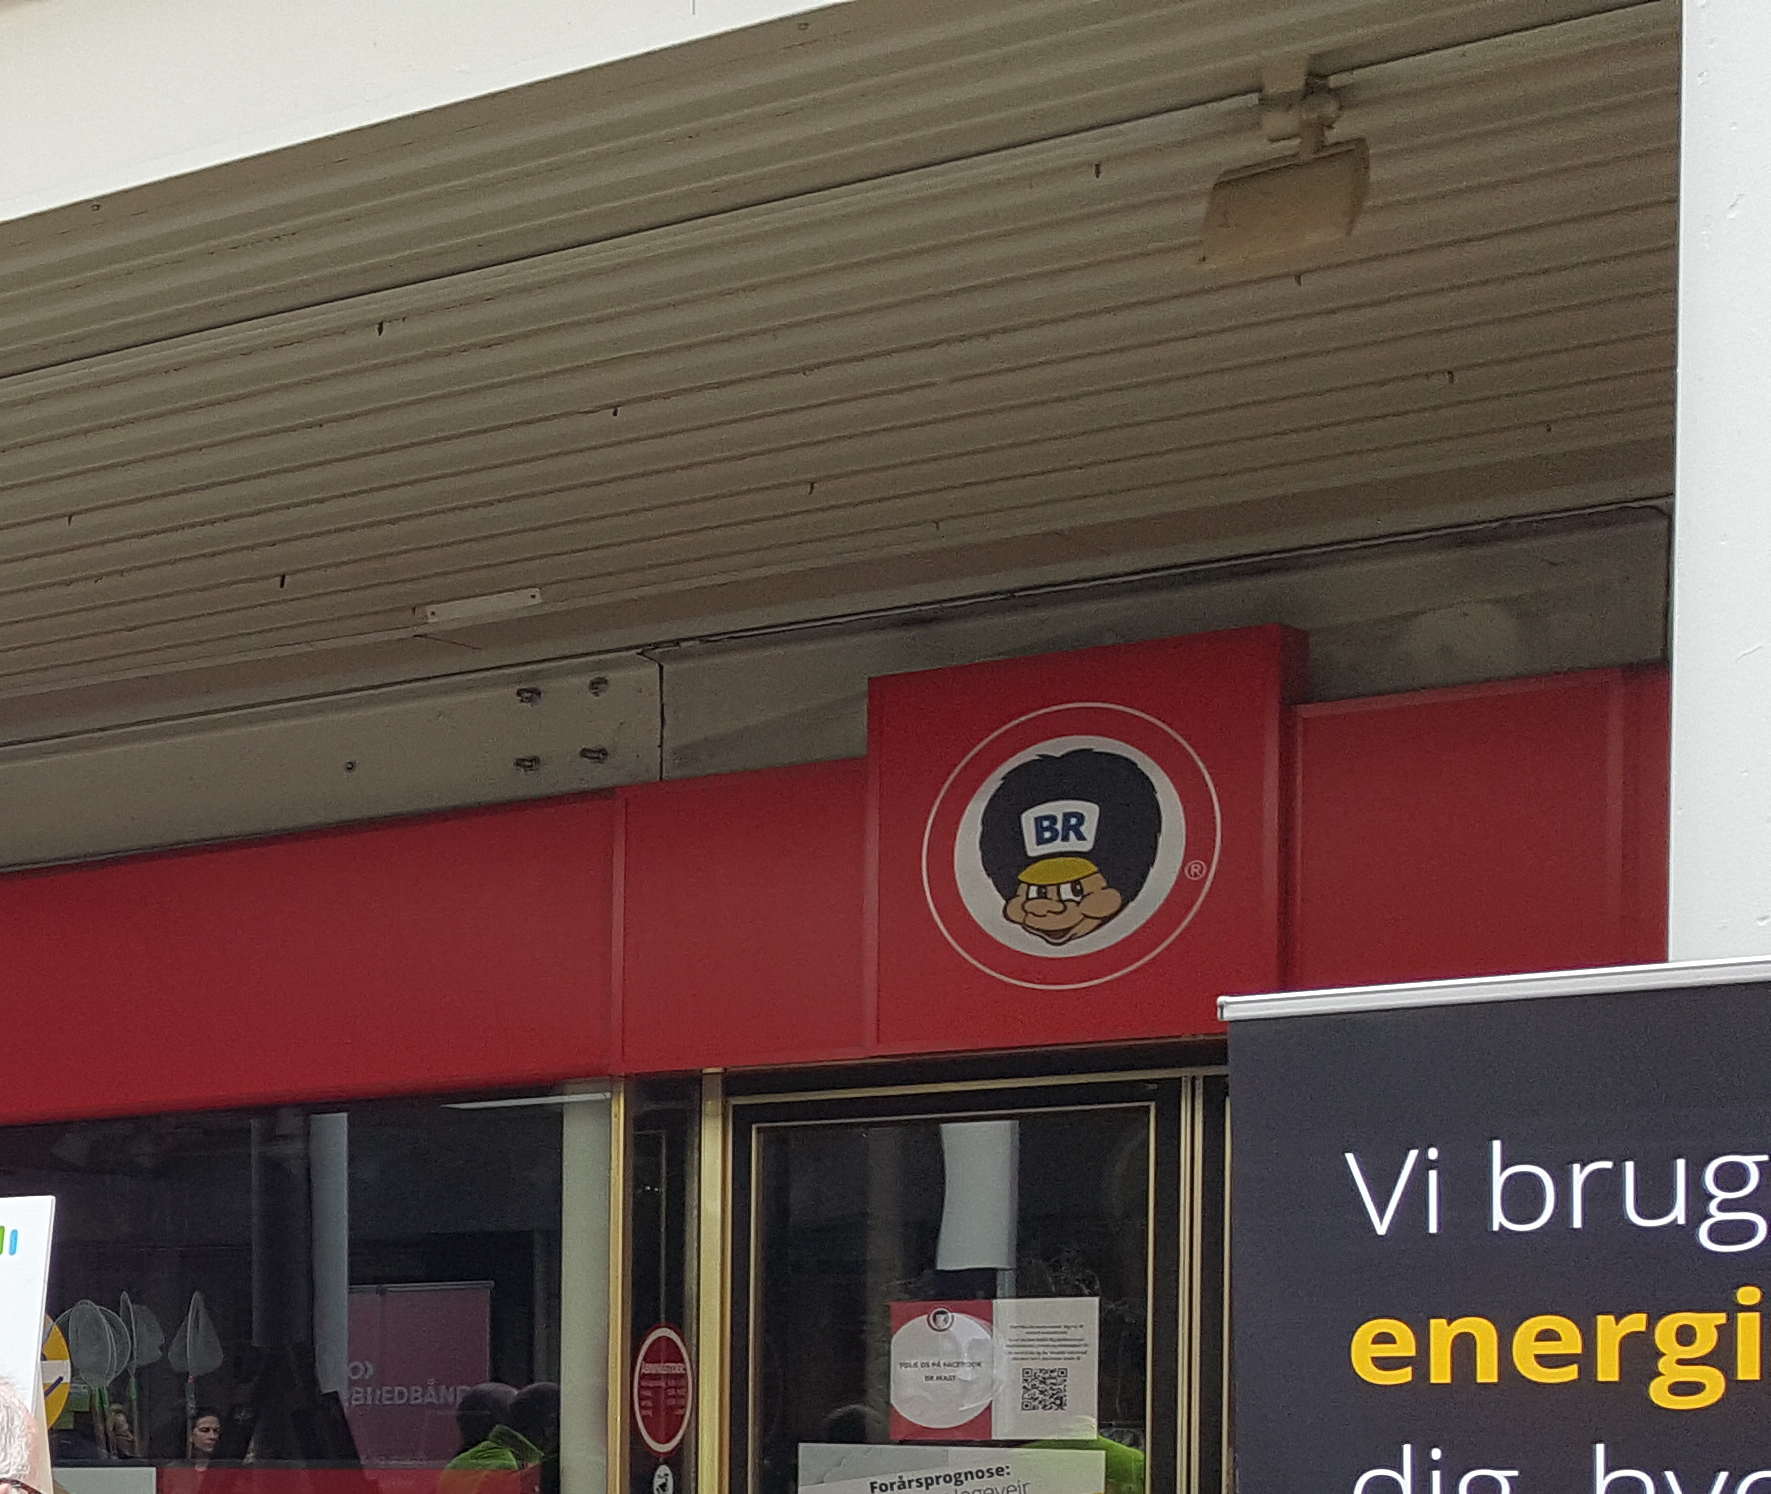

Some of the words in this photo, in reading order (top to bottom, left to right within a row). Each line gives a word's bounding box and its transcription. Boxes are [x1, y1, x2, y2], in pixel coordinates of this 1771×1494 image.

[1033, 811, 1088, 846] BR
[1344, 1147, 1439, 1236] Vi
[1491, 1139, 1769, 1253] brug
[1349, 1285, 1763, 1411] energi
[869, 1464, 1012, 1494] Forårsprognose:
